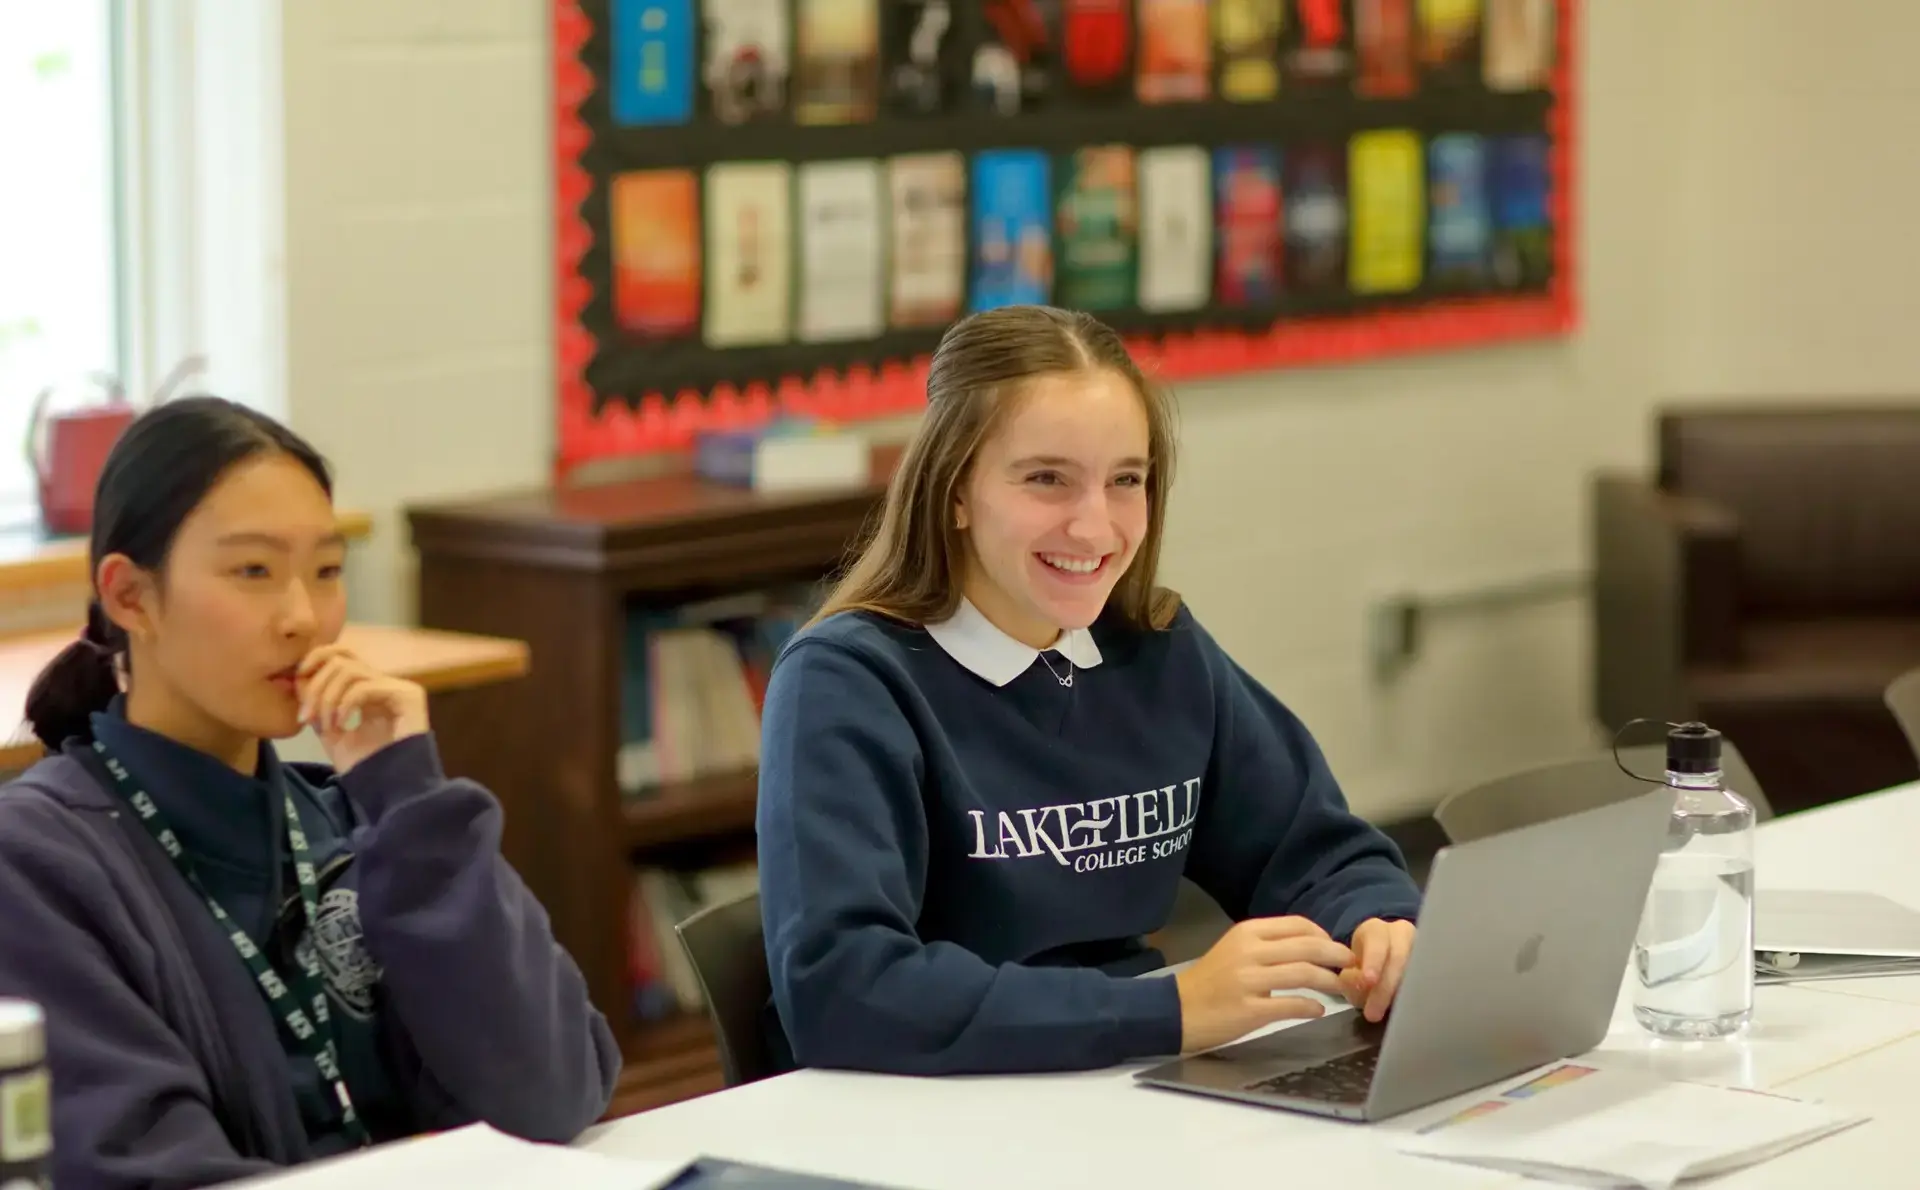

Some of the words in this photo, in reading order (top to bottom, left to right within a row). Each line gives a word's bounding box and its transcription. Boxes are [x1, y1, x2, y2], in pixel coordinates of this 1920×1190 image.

[967, 776, 1201, 866] LAKEFIELD
[1074, 846, 1147, 873] COLLEGE
[1152, 828, 1193, 860] SCHOO
